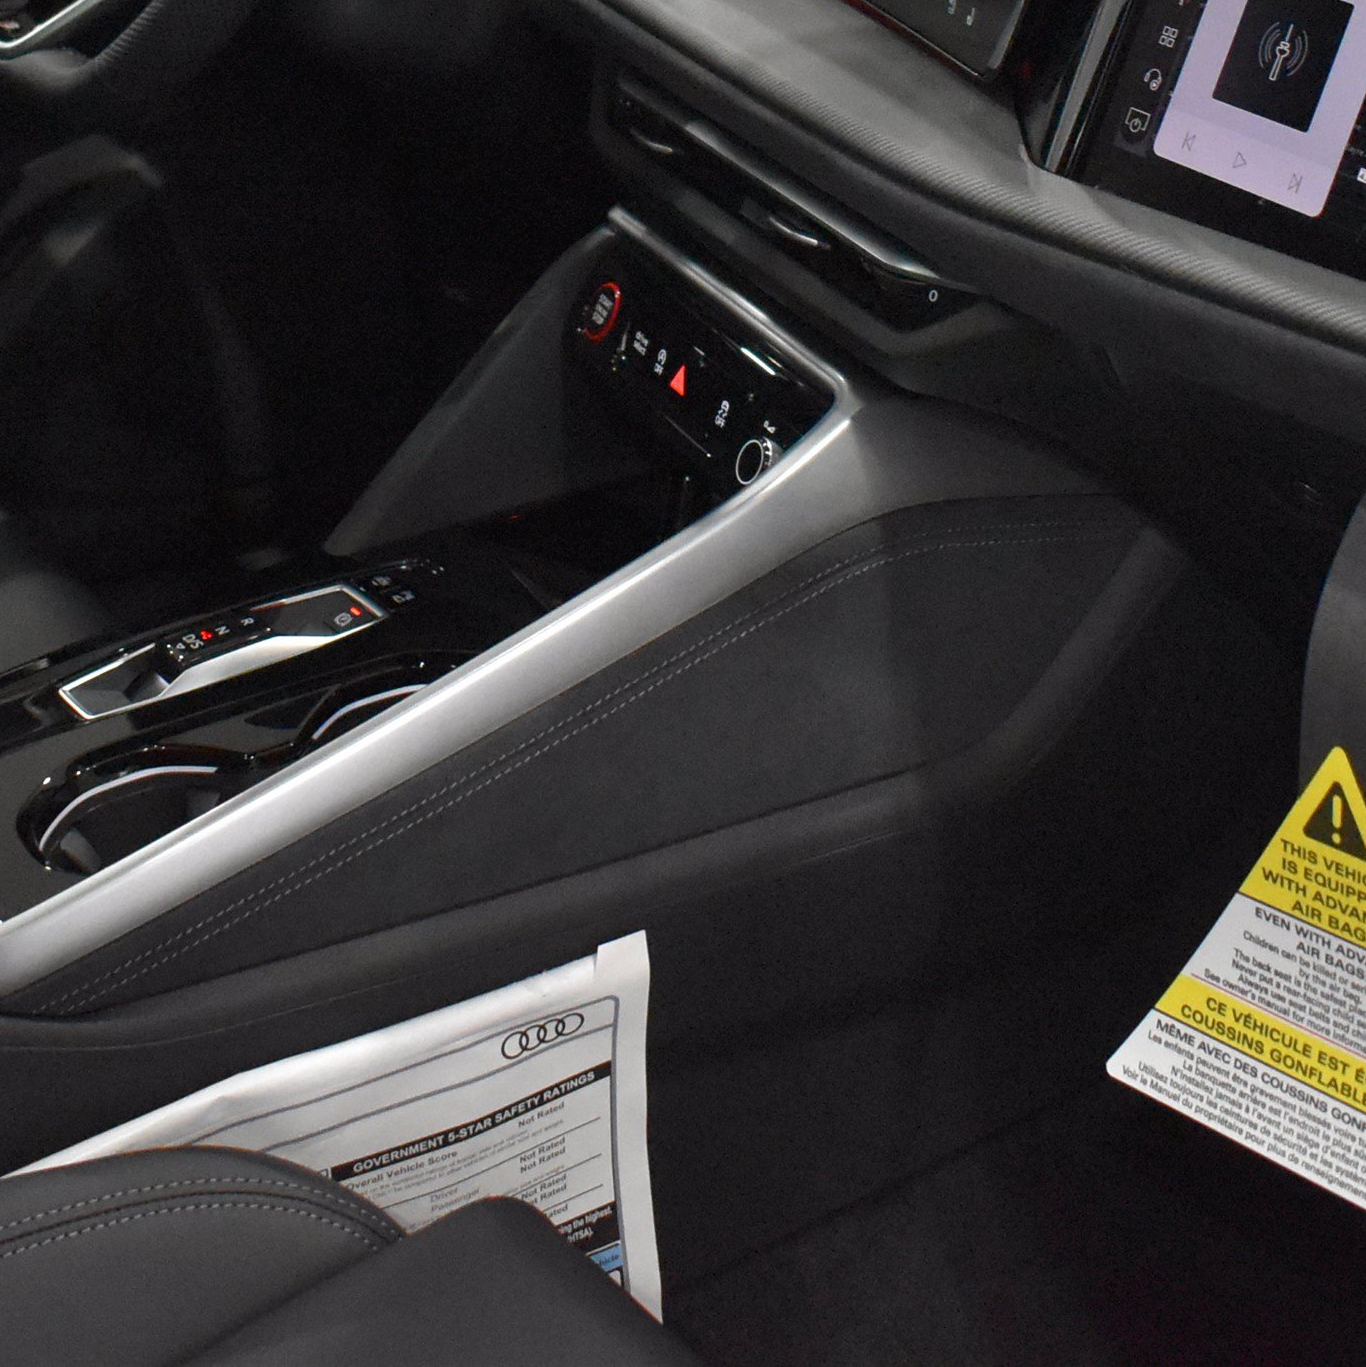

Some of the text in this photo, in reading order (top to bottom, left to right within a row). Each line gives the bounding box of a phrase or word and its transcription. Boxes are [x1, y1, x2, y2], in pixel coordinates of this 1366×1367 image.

[1280, 837, 1317, 865] THIS
[1281, 856, 1298, 875] IS
[1261, 866, 1307, 898] WITH
[1254, 905, 1291, 931] EVEN
[1294, 923, 1331, 950] WITH
[1290, 899, 1322, 923] AIR
[1242, 930, 1279, 954] Children
[1311, 962, 1337, 981] killed
[1295, 940, 1320, 960] AIR
[1221, 978, 1256, 1001] owner's
[1257, 995, 1290, 1017] manual
[1306, 1019, 1331, 1037] more
[1231, 958, 1258, 978] Never
[1282, 983, 1330, 1014] rear-facing
[1331, 1007, 1355, 1024] child
[1236, 973, 1269, 995] Always
[1287, 998, 1306, 1013] seat
[1308, 1006, 1330, 1024] belts
[1251, 956, 1272, 974] back
[1273, 968, 1292, 984] seat
[1319, 990, 1347, 1009] safest
[1342, 987, 1362, 1005] bag.
[1180, 1003, 1264, 1055] COUSSINS
[1205, 996, 1227, 1017] CE
[1231, 1007, 1312, 1058] VÉHICULE
[1316, 1049, 1350, 1076] EST
[1155, 1017, 1195, 1047] MÊME
[1196, 1040, 1231, 1065] AVEC
[1232, 1056, 1258, 1078] DES
[1260, 1071, 1327, 1113] COUSSINS
[347, 1102, 565, 1191] Overall Vehicle Score Not Rated
[353, 1071, 595, 1173] GOVERNMENT 5-STAR SAFETY RATINGS
[430, 1137, 566, 1203] Driver Not Rated
[519, 1160, 536, 1174] Not
[537, 1147, 566, 1165] Rated
[521, 1185, 538, 1201] Not
[538, 1174, 567, 1191] Rated
[539, 1184, 567, 1201] Rated
